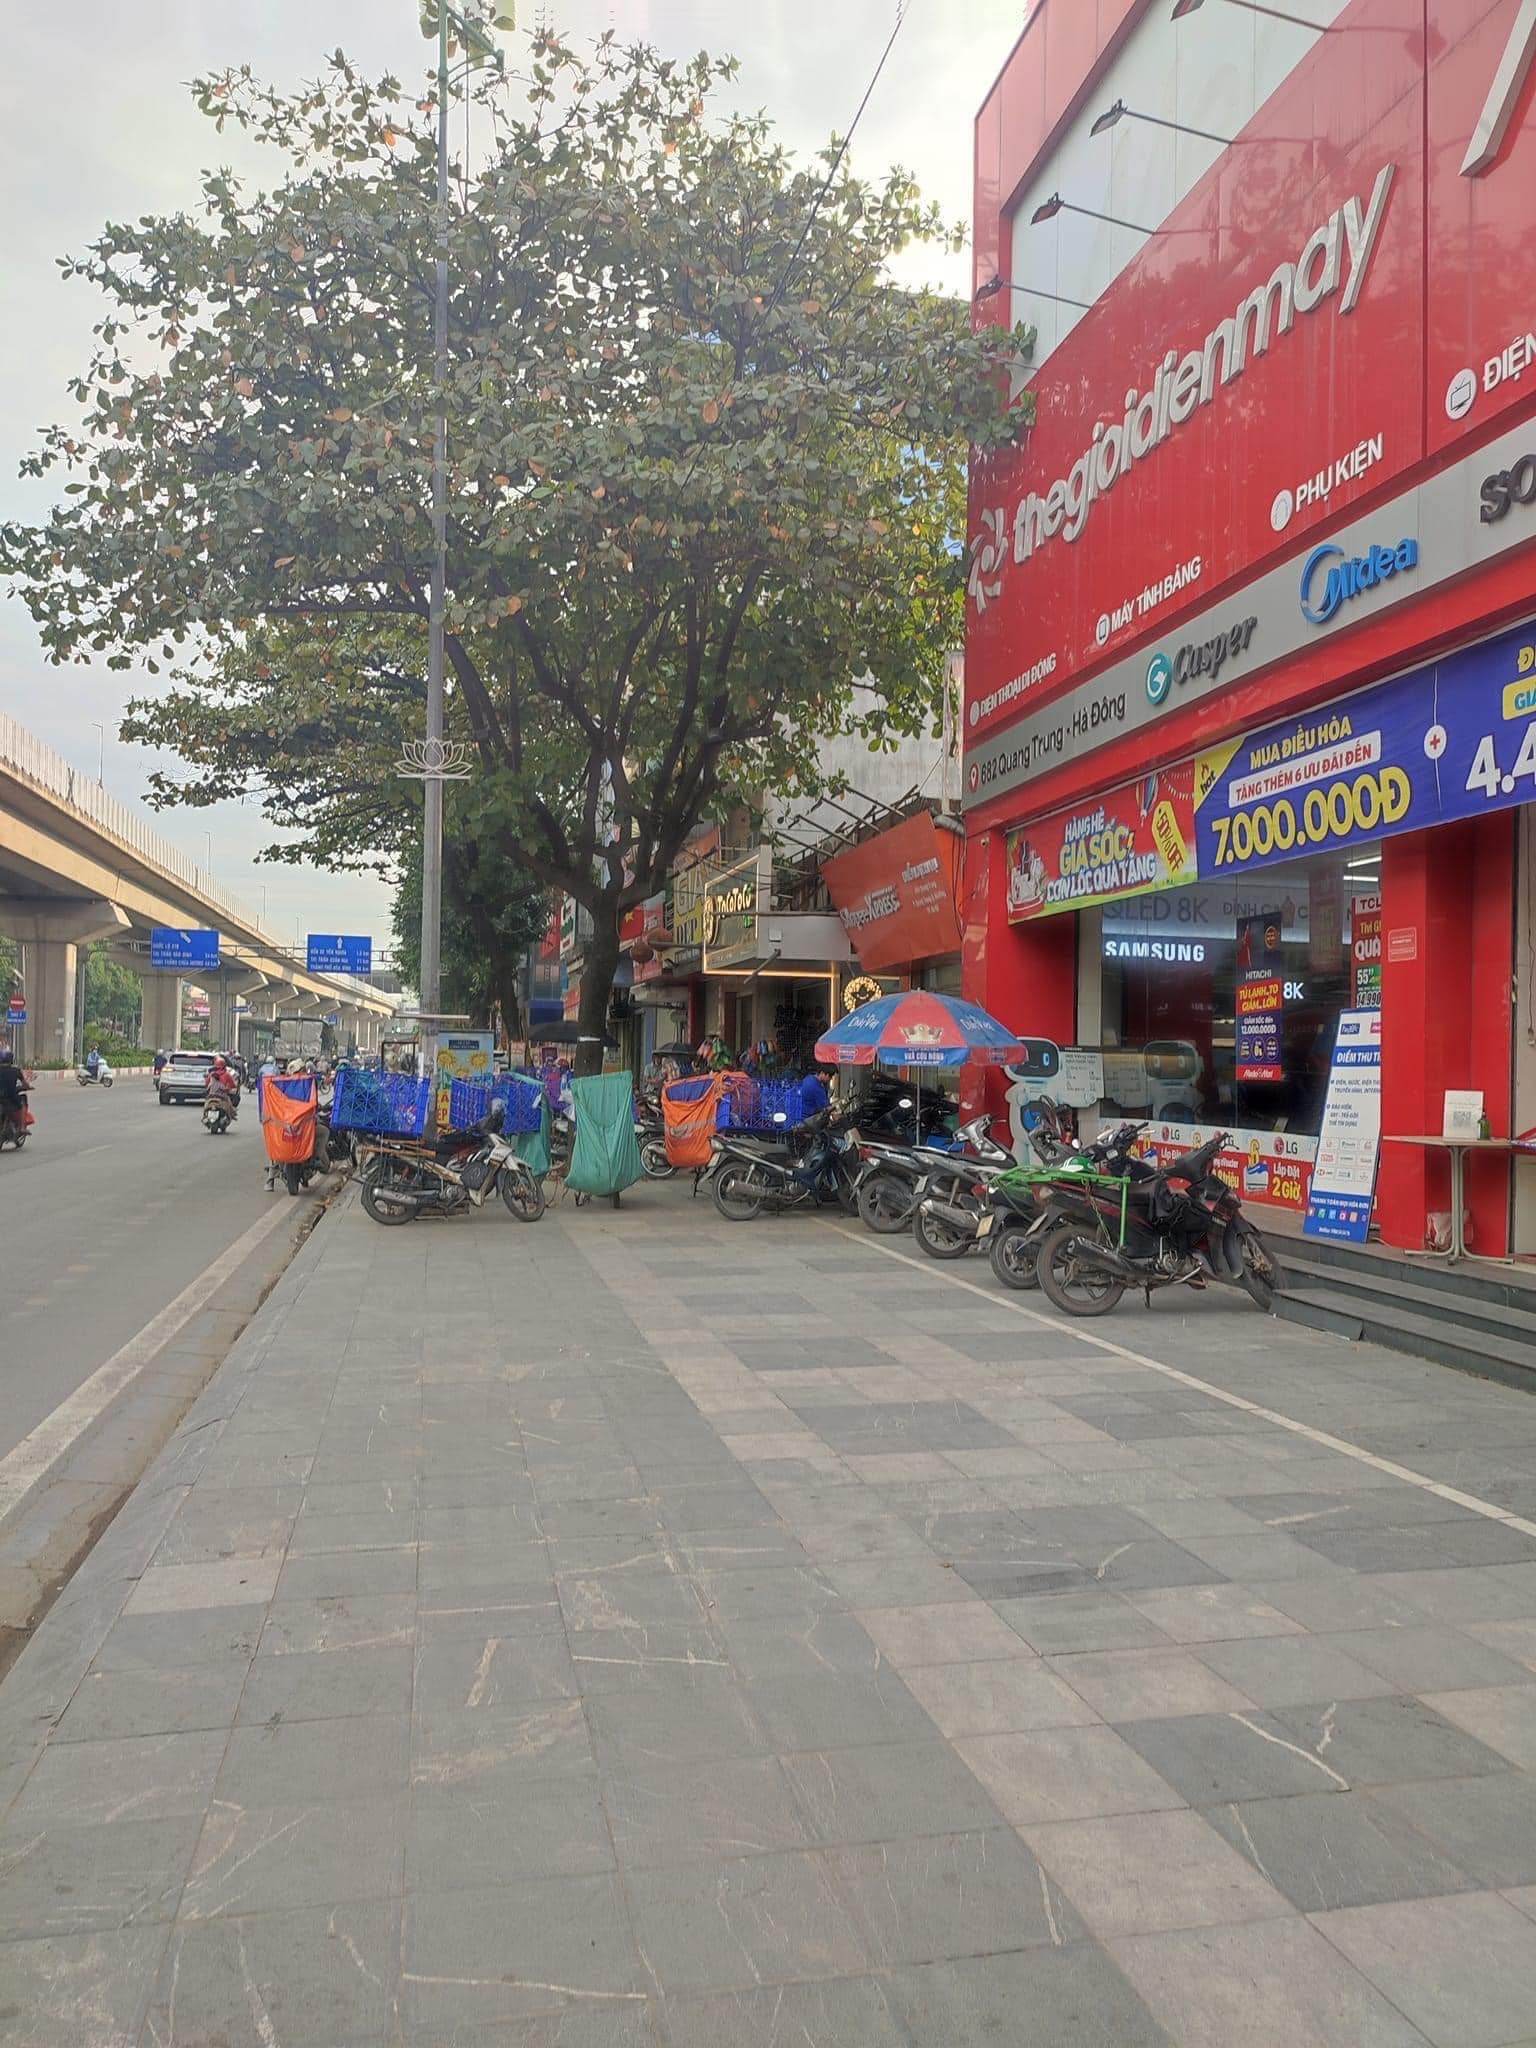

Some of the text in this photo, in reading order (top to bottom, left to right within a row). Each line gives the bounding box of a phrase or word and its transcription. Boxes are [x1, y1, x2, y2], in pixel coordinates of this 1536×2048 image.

[1013, 162, 1396, 563] thegioidienmay
[1296, 432, 1384, 513] PHỤ KIỆN
[1111, 556, 1201, 633] MÁY TÍNH BẢNG
[1300, 538, 1418, 624] Midea
[1174, 616, 1257, 684] Casper
[997, 677, 1021, 706] THOẠI
[1021, 670, 1030, 690] DI
[1031, 653, 1056, 684] ĐỘNG
[981, 757, 998, 785] 682
[999, 744, 1031, 774] Quang
[1032, 727, 1064, 761] Trung
[1072, 711, 1088, 737] Hà
[1091, 693, 1126, 726] Đông
[1249, 714, 1352, 771] MUA ĐIỀU HÒA
[1263, 769, 1293, 792] THÊM
[1295, 768, 1302, 782] 6
[1304, 761, 1321, 778] ƯU
[1322, 752, 1343, 772] ĐÃI
[1345, 739, 1372, 766] ĐẾN
[1201, 769, 1217, 796] hot
[1065, 815, 1090, 843] HÀNG
[1211, 766, 1412, 867] 7.000.000Đ
[1089, 819, 1129, 868] SỐC
[1095, 860, 1120, 892] QUÀ
[1177, 898, 1209, 924] 8K
[1360, 898, 1381, 910] TCL
[1105, 941, 1205, 962] SAMSUNG
[1246, 969, 1272, 980] HITACHI
[1284, 982, 1304, 1000] 8K
[1357, 1051, 1373, 1062] THU
[1170, 1128, 1180, 1140] LG
[1286, 1141, 1298, 1155] LG
[1273, 1162, 1300, 1178] Lắp Đặt
[1272, 1177, 1281, 1197] 2
